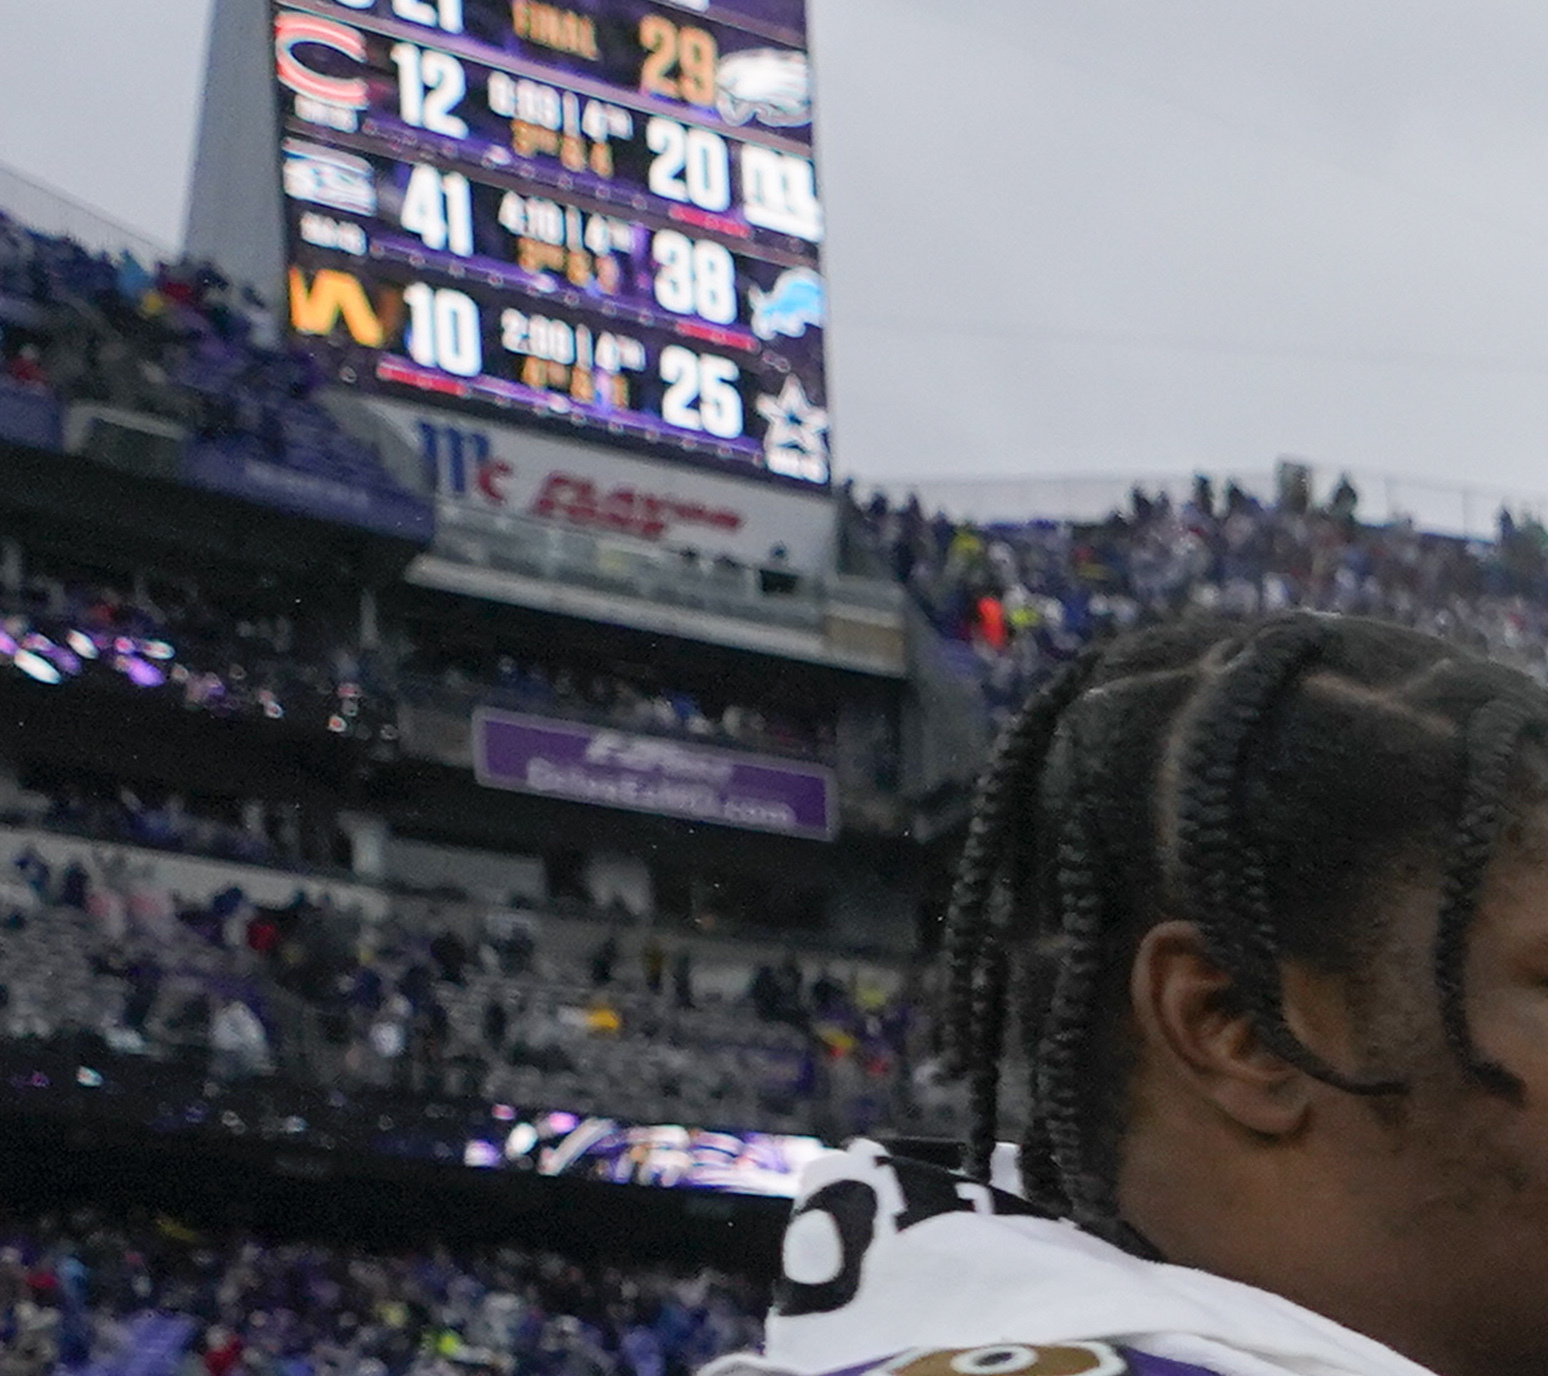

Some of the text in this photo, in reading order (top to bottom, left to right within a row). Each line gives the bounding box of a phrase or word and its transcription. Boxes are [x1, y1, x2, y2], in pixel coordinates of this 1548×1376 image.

[390, 41, 469, 140] 12
[647, 114, 730, 213] 20
[641, 15, 717, 107] 29
[401, 163, 473, 257] 41
[653, 229, 738, 326] 38
[402, 281, 482, 378] 10
[660, 343, 744, 440] 25
